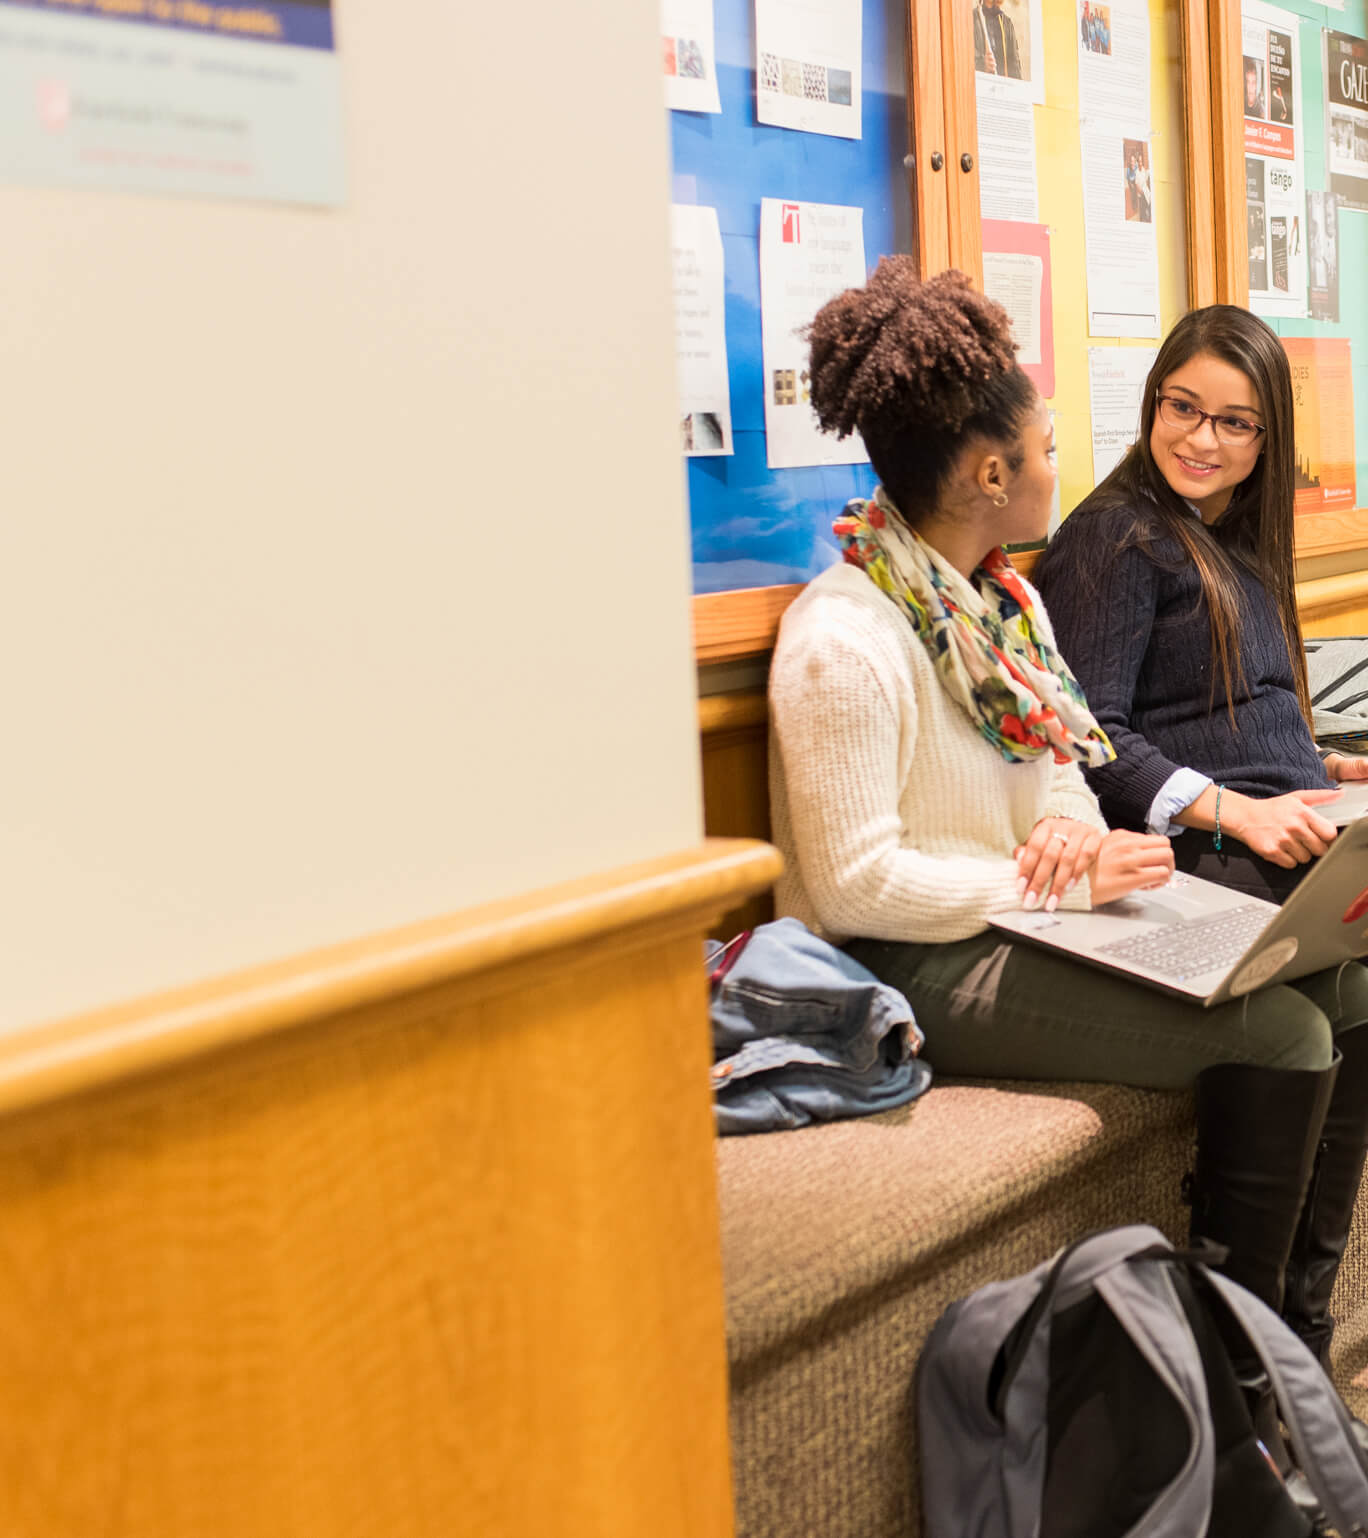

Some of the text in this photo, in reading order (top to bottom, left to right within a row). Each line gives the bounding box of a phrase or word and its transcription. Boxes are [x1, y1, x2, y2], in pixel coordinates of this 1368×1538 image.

[1340, 60, 1368, 104] GAZE
[1270, 169, 1292, 191] tango
[1292, 366, 1309, 380] DIES
